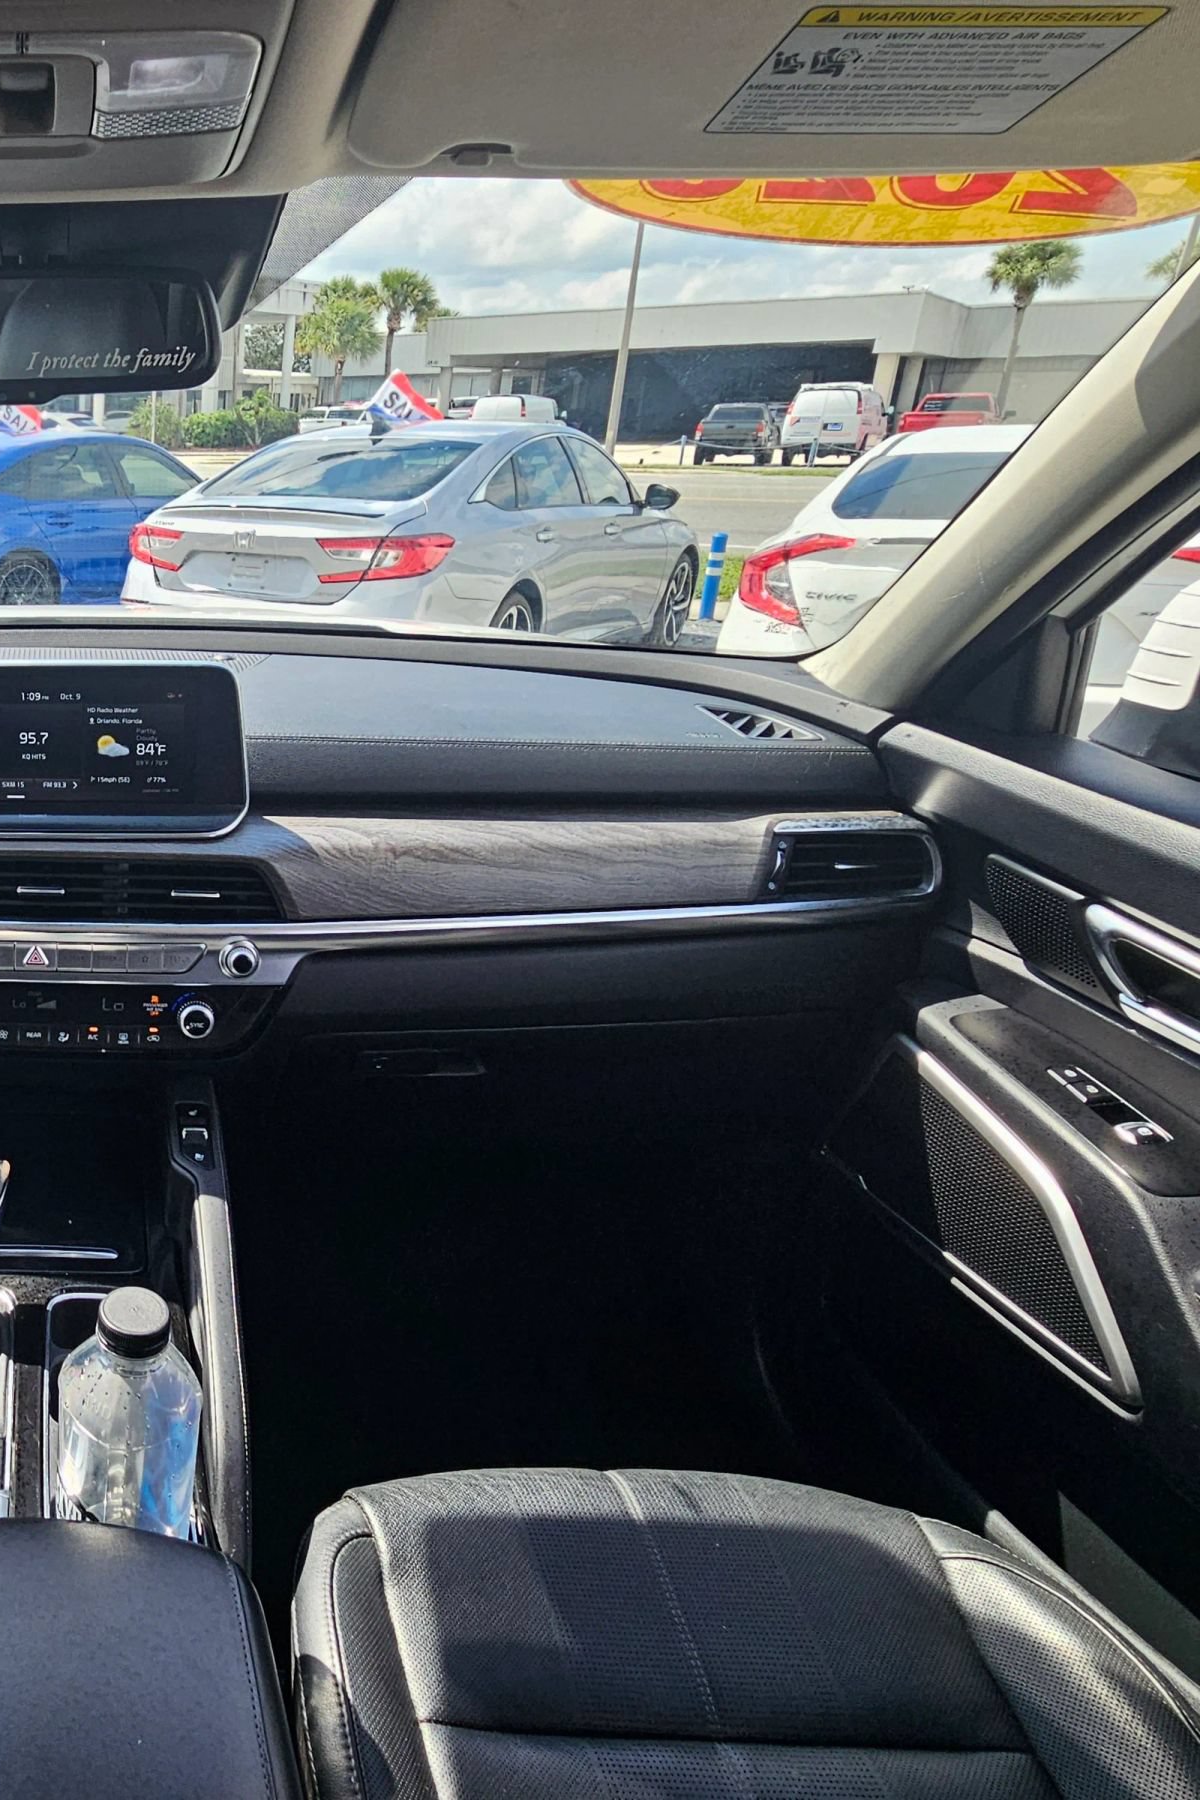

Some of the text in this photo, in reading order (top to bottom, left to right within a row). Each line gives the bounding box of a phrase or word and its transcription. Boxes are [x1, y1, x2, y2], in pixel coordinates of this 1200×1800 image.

[856, 9, 1144, 24] WARNING/AVERTISSEMENT
[842, 31, 1087, 40] EVEN WITH ADVANCED AIR BAGS
[26, 346, 196, 377] I protect the family
[805, 591, 858, 601] CIVIC
[20, 692, 41, 701] 1:09
[60, 693, 75, 701] Oct.
[19, 732, 49, 745] 95.7
[136, 742, 166, 756] 84°F
[88, 1033, 99, 1041] A/C
